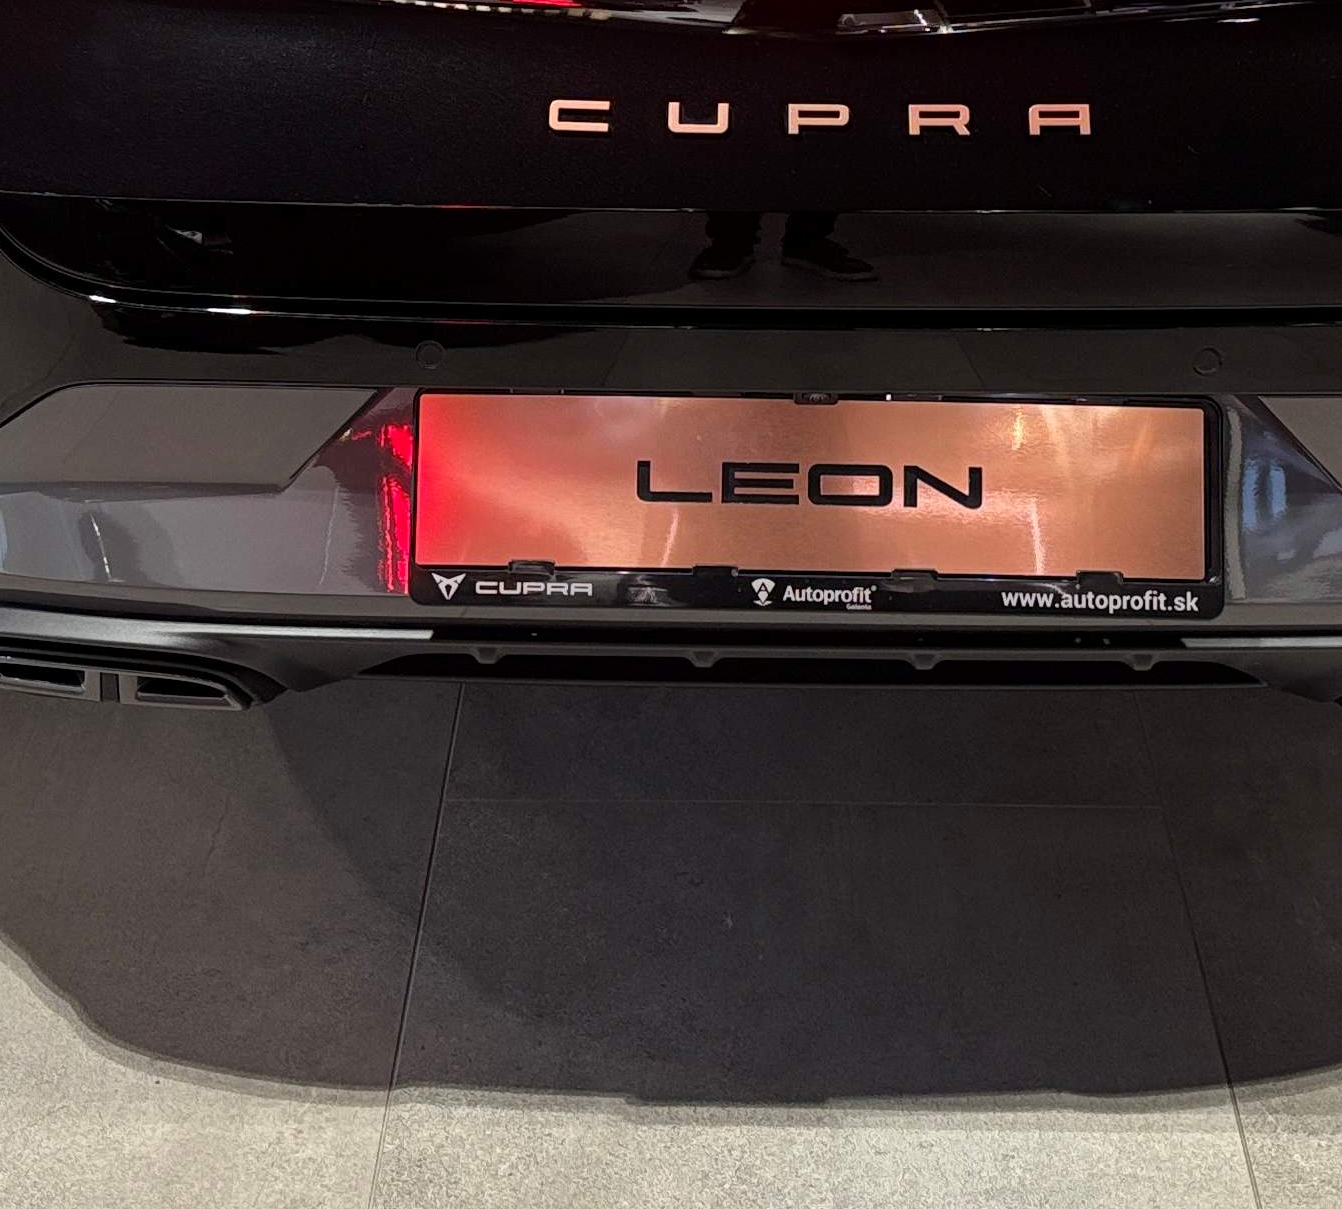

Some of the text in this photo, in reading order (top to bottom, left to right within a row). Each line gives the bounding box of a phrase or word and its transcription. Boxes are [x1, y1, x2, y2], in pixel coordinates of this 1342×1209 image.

[548, 99, 1092, 137] CUPRA
[636, 460, 983, 510] LEON
[475, 581, 593, 597] CUPRA
[782, 584, 873, 605] Autoprofit
[1001, 590, 1199, 614] www.autoprofit.sk
